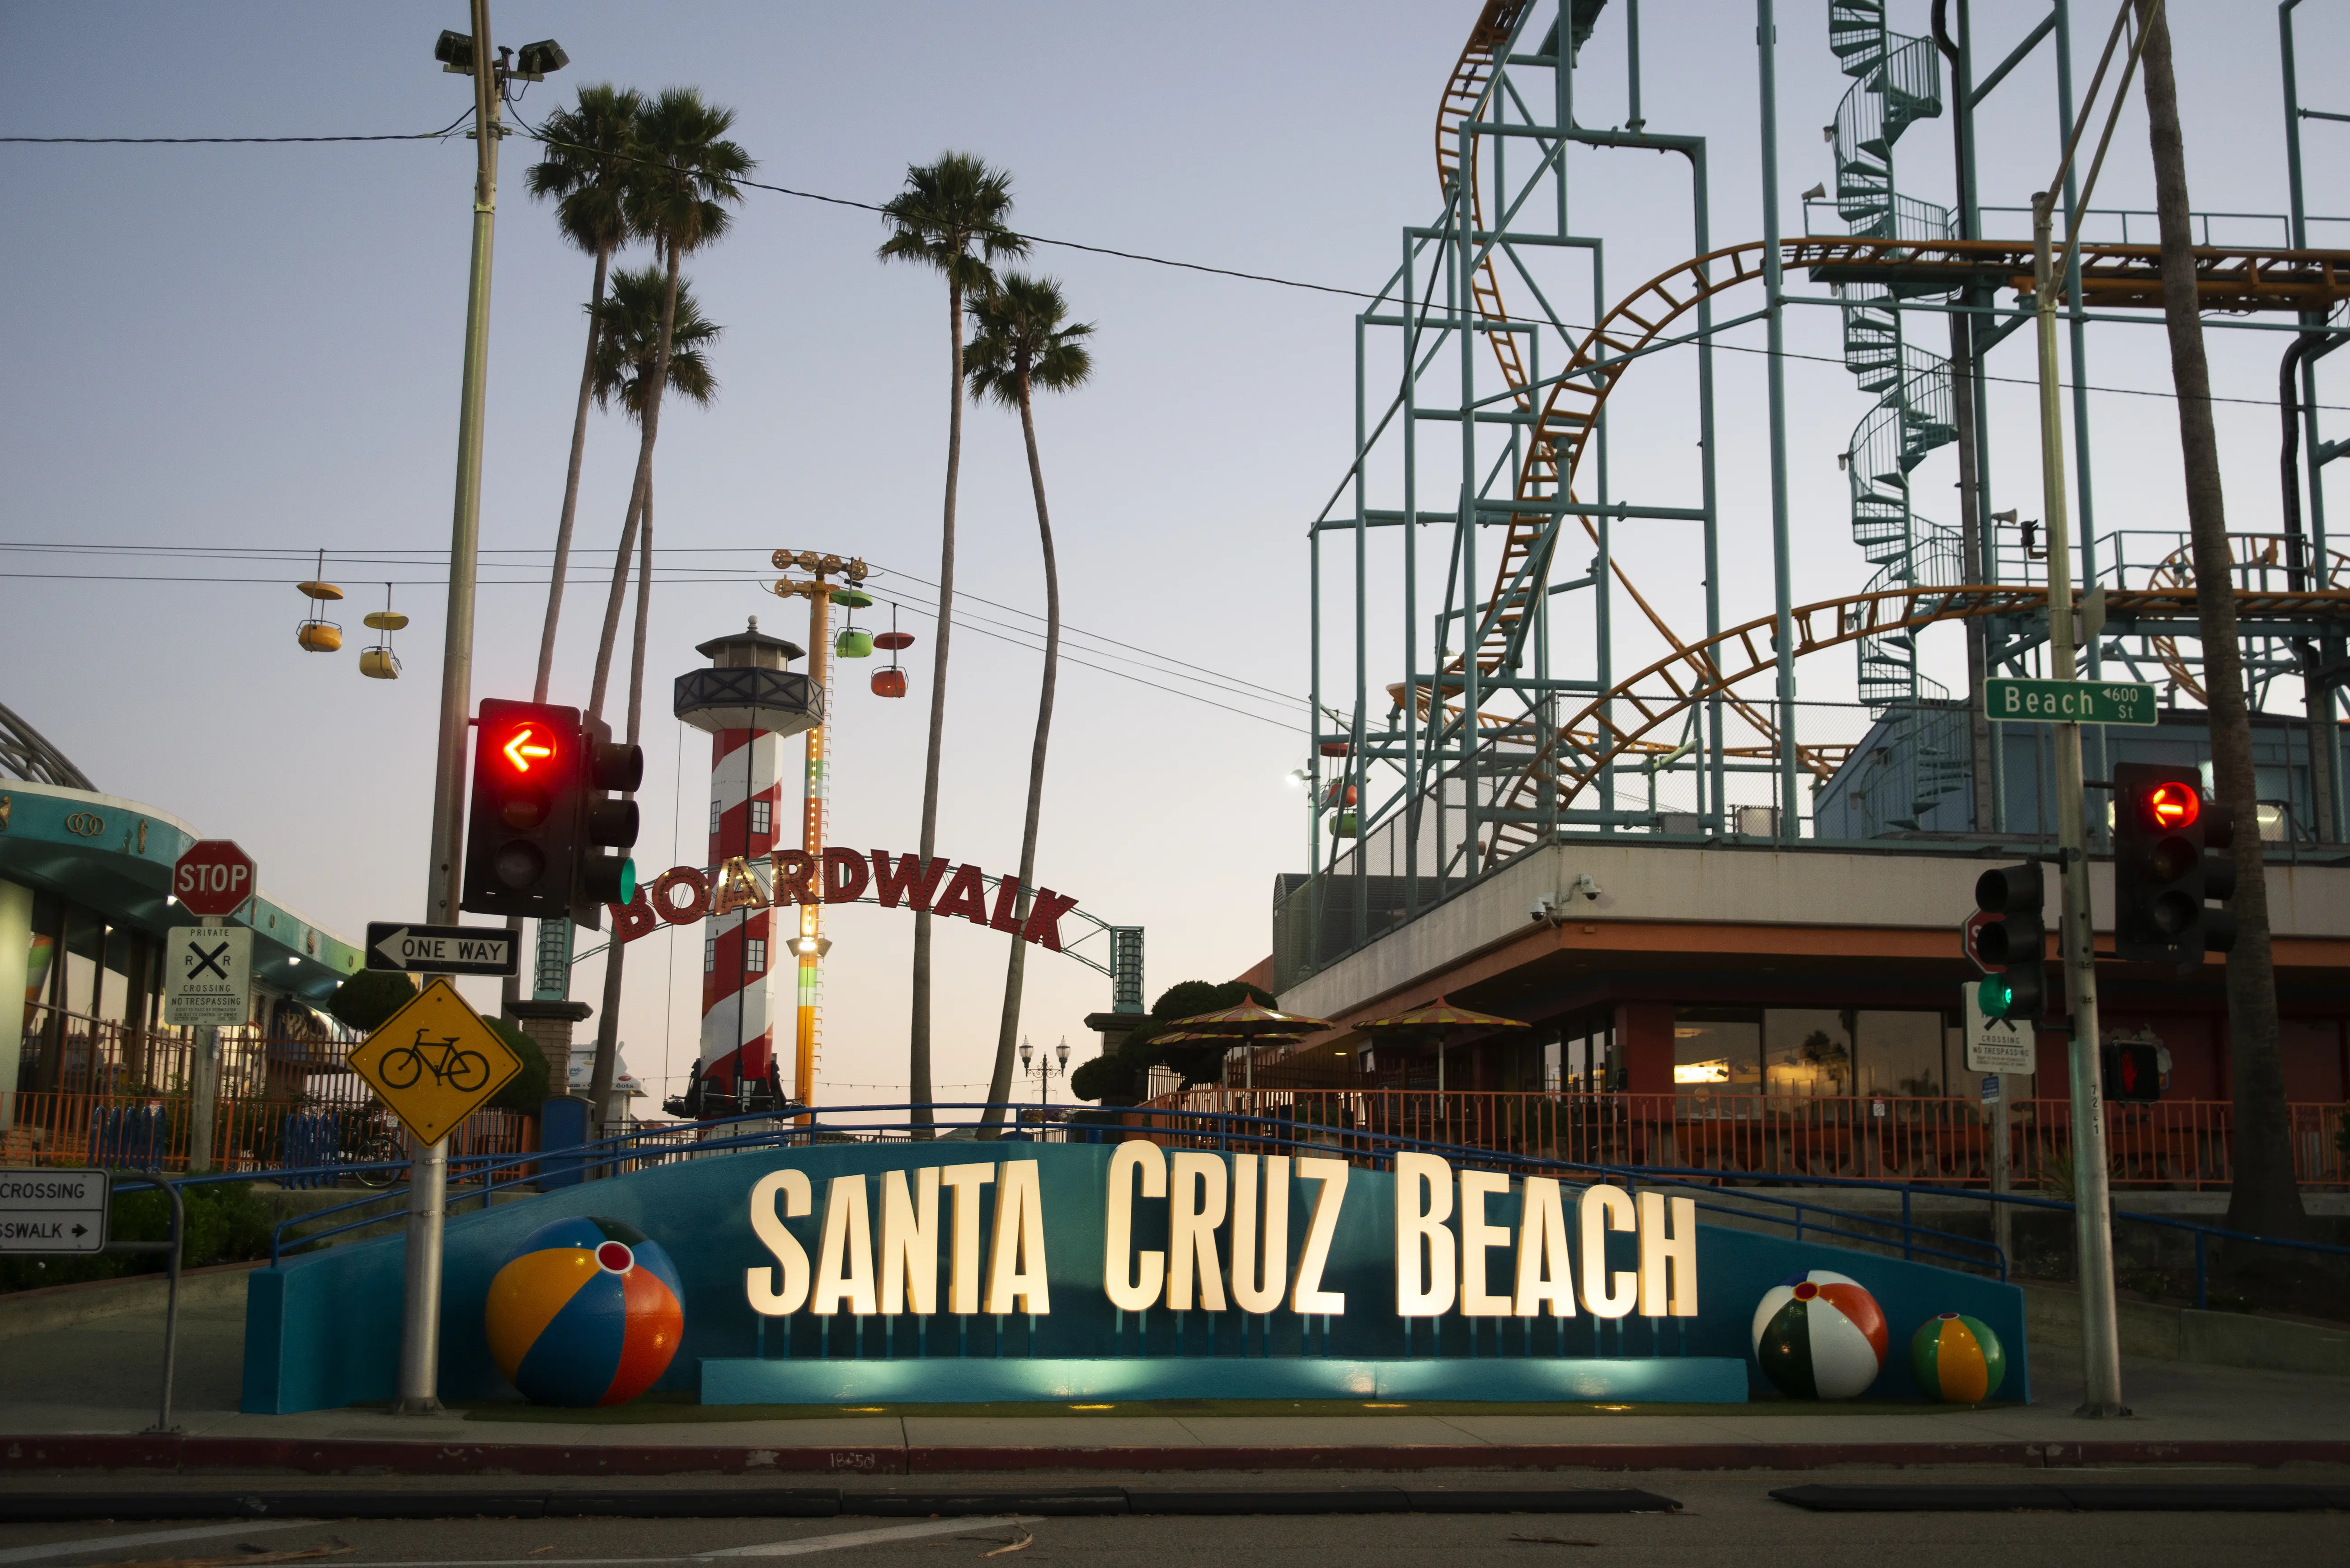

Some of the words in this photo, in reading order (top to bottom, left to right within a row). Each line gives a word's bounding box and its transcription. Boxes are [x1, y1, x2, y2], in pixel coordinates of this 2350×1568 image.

[2005, 686, 2093, 714] Beach
[2112, 688, 2138, 702] 600
[2118, 704, 2134, 719] St
[179, 864, 248, 892] STOP
[609, 846, 1080, 953] BOARDWALK
[402, 939, 445, 958] ONE
[459, 942, 503, 960] WAY
[186, 955, 193, 966] R
[223, 955, 230, 966] R
[183, 984, 230, 992] CROSSING
[186, 997, 241, 1005] TRESPASSING
[1982, 1035, 2020, 1044] CROSSING
[1984, 1047, 2029, 1056] TRESPASSING
[0, 1183, 85, 1198] CROSSING
[743, 1159, 1050, 1317] SANTA
[1103, 1139, 1349, 1314] CRUZ
[1394, 1151, 1698, 1319] BEACH
